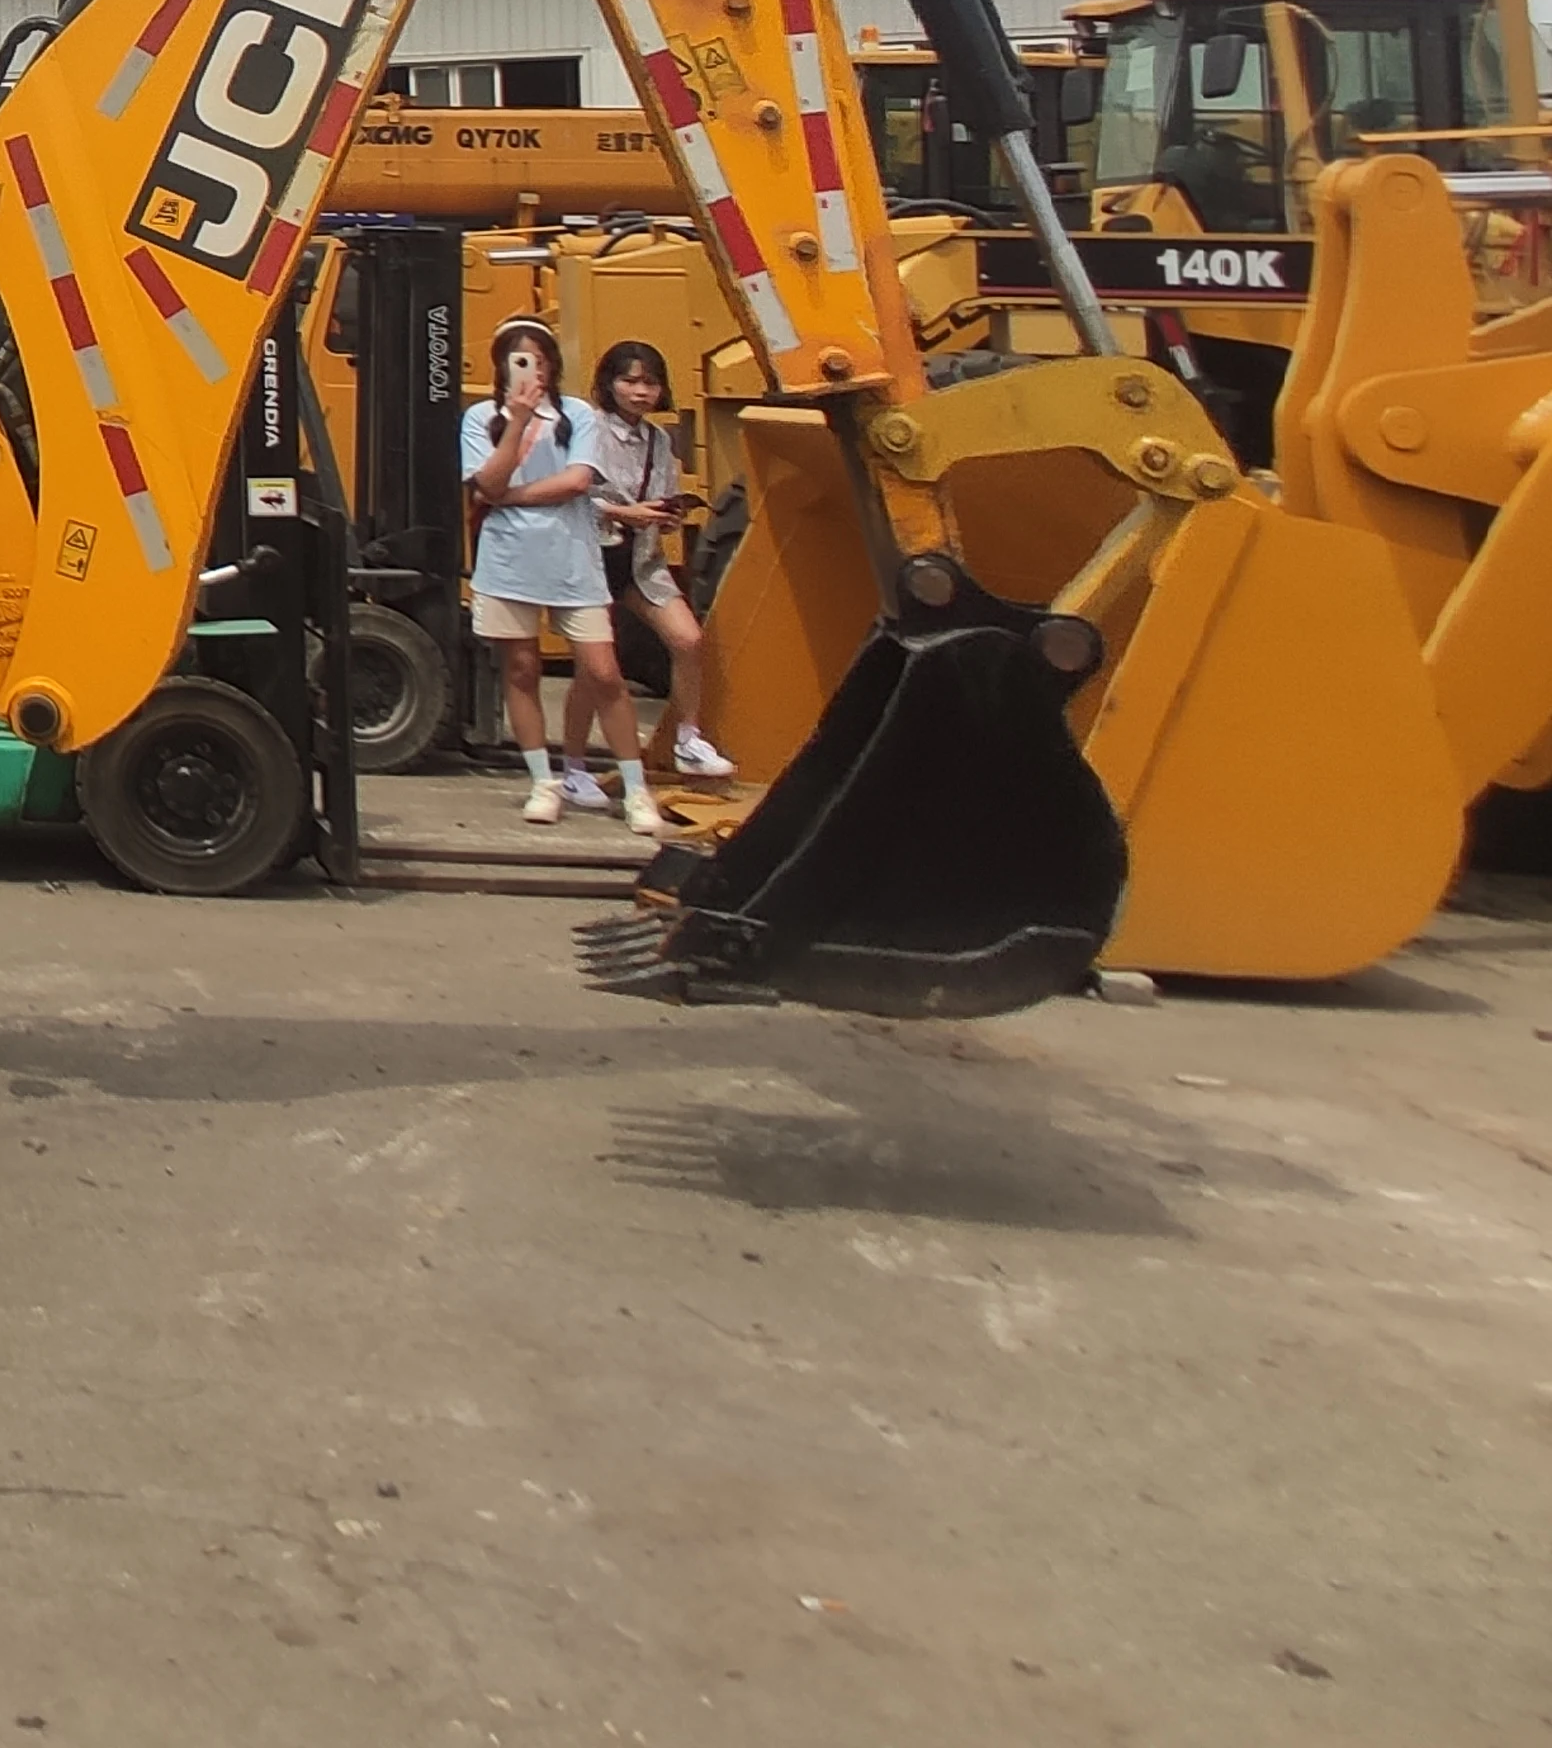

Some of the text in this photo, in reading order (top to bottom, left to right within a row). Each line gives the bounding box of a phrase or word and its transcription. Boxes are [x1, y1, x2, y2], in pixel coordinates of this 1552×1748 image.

[457, 128, 541, 149] QY70K
[1156, 248, 1286, 288] 140K
[427, 305, 449, 403] TOYOTA
[263, 338, 282, 449] GRENDIA
